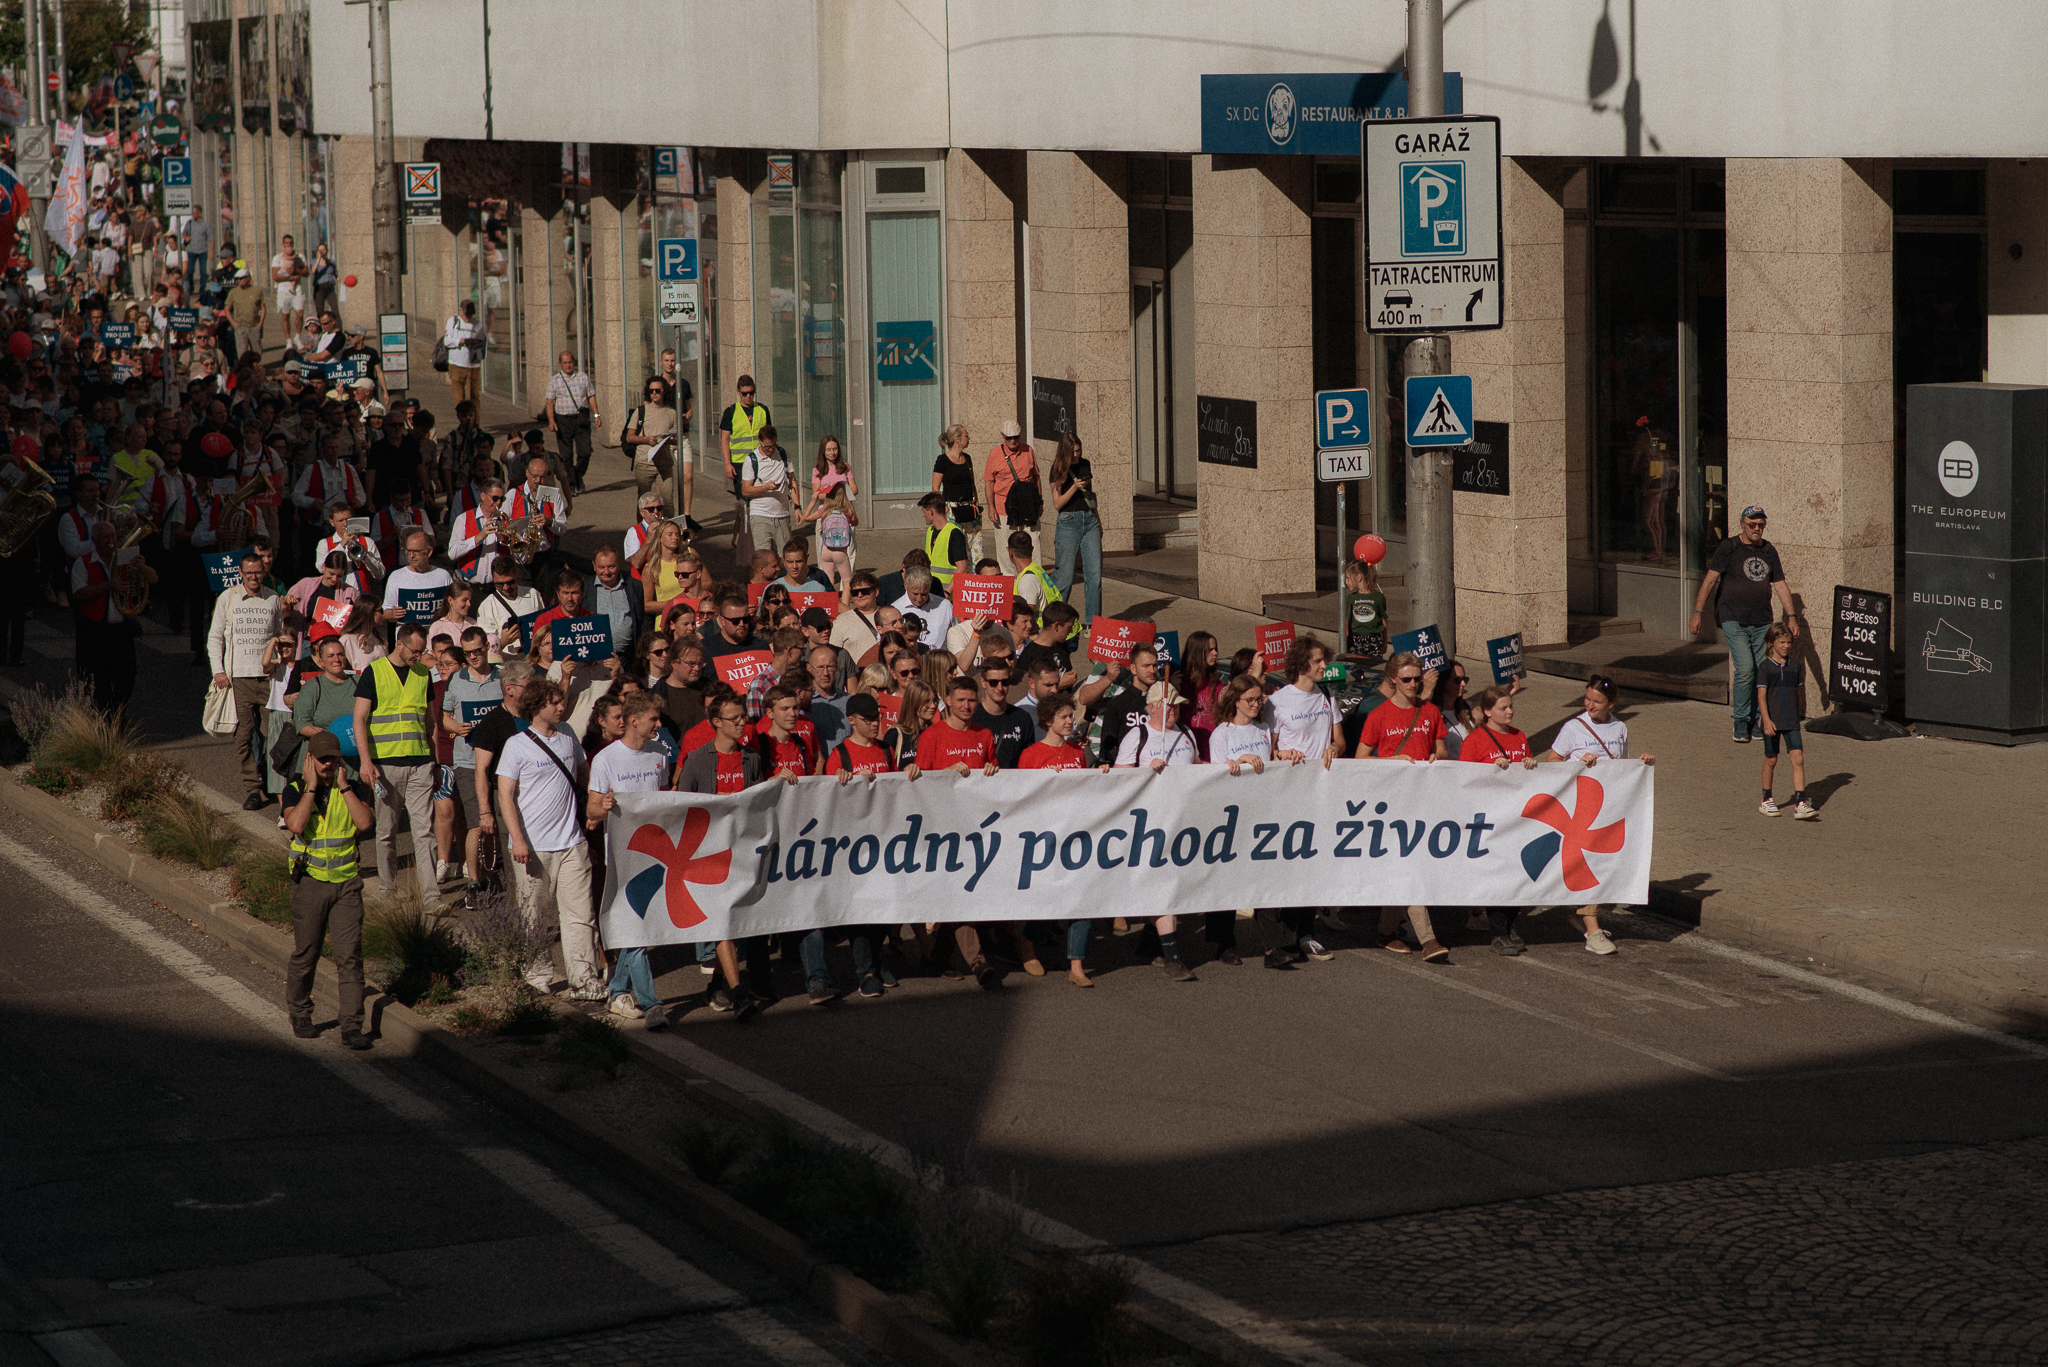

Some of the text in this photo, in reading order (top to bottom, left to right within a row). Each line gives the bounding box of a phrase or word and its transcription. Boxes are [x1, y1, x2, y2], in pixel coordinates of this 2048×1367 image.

[1226, 106, 1240, 122] SX
[1243, 106, 1260, 122] DG
[1301, 106, 1381, 122] RESTAURANT
[1395, 127, 1471, 153] GARÁŽ
[664, 244, 686, 276] P
[1371, 264, 1496, 286] TATRACENTRUM
[676, 291, 691, 299] min.
[1377, 310, 1422, 326] 400 m
[1200, 400, 1232, 436] Lunch
[1326, 398, 1354, 441] P
[1328, 456, 1362, 473] TAXI
[1911, 505, 2006, 520] THE EUROPEUM
[1935, 522, 1981, 531] BRATISLAVA
[964, 580, 1003, 589] Materstvo
[417, 591, 435, 599] Dieťa
[961, 590, 1004, 606] NIE JE
[1913, 592, 1976, 608] BUILDING
[406, 600, 429, 612] NIE
[975, 606, 999, 616] predaj
[1840, 610, 1879, 625] ESPRESSO
[570, 622, 594, 633] SOM
[1265, 628, 1289, 638] Materstvo
[1843, 626, 1877, 644] 1,50€
[558, 630, 606, 646] ZA ŽIVOT
[1264, 640, 1281, 655] NIE
[734, 655, 756, 666] Dieťa
[1269, 658, 1275, 666] na
[726, 665, 754, 681] NIE
[1837, 662, 1881, 676] Breakfast menu
[1841, 675, 1877, 696] 4,90€
[755, 800, 1495, 893] národný pochod za život
